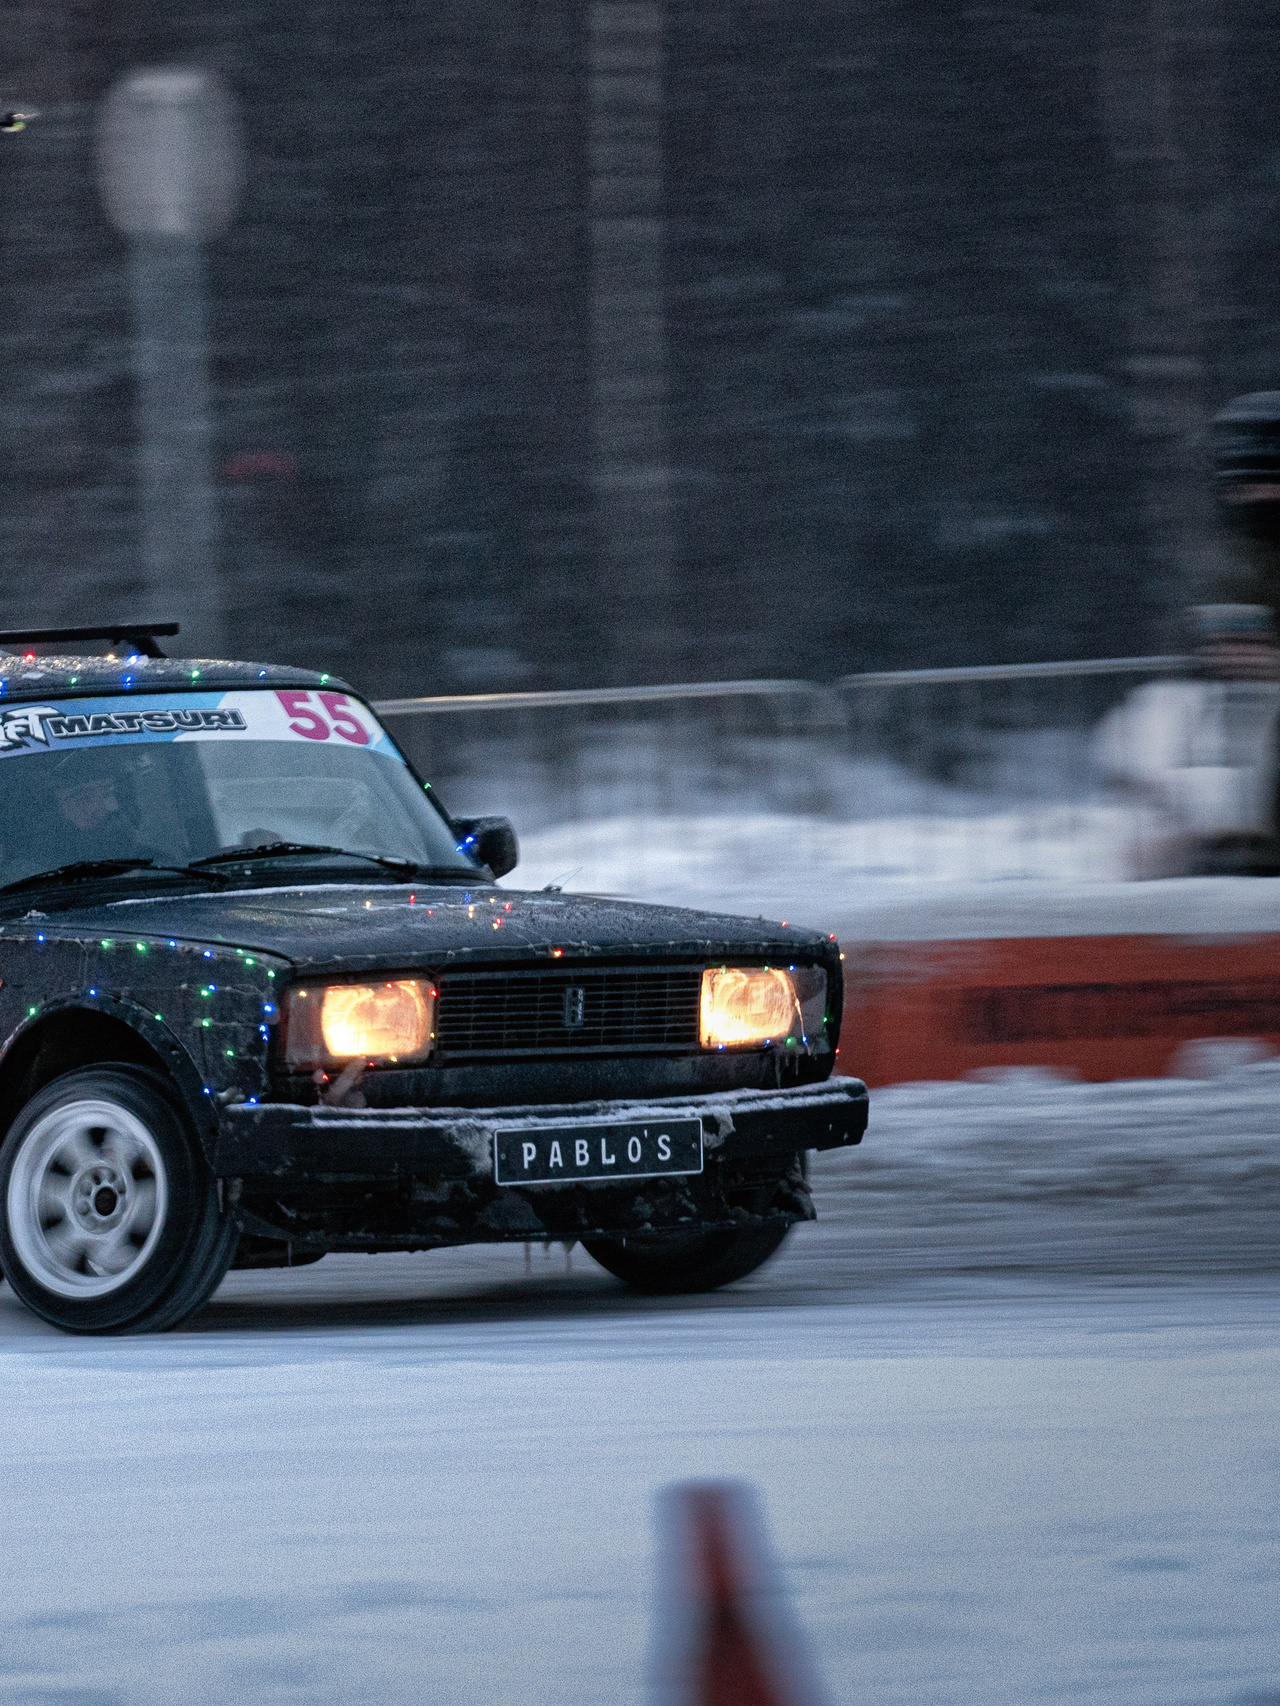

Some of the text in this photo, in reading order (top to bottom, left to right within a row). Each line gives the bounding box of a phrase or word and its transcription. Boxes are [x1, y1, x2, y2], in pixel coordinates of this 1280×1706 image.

[46, 708, 247, 739] MATSURI
[273, 691, 370, 745] 55
[522, 1129, 671, 1170] PABLO'S
